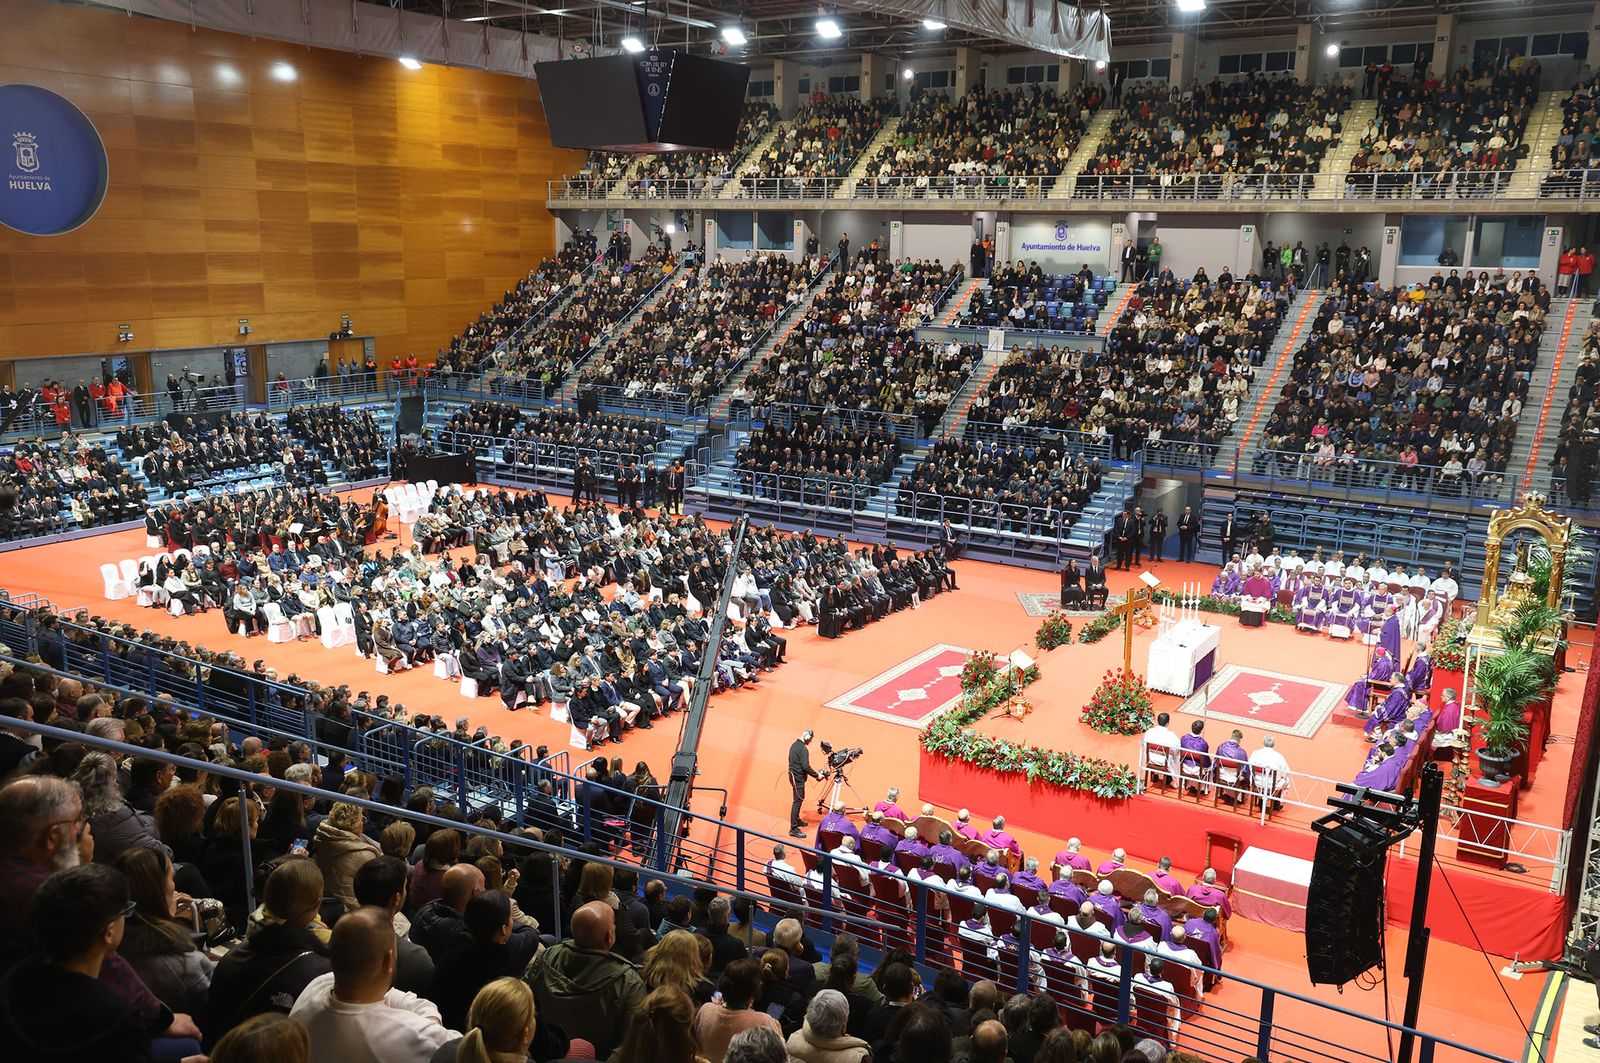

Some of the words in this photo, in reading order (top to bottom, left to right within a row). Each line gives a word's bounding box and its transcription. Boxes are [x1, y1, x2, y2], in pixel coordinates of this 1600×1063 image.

[9, 180, 52, 191] HUELVA
[1021, 243, 1066, 251] Ayuntamiento
[1067, 243, 1076, 251] de
[1076, 243, 1101, 251] Huelva
